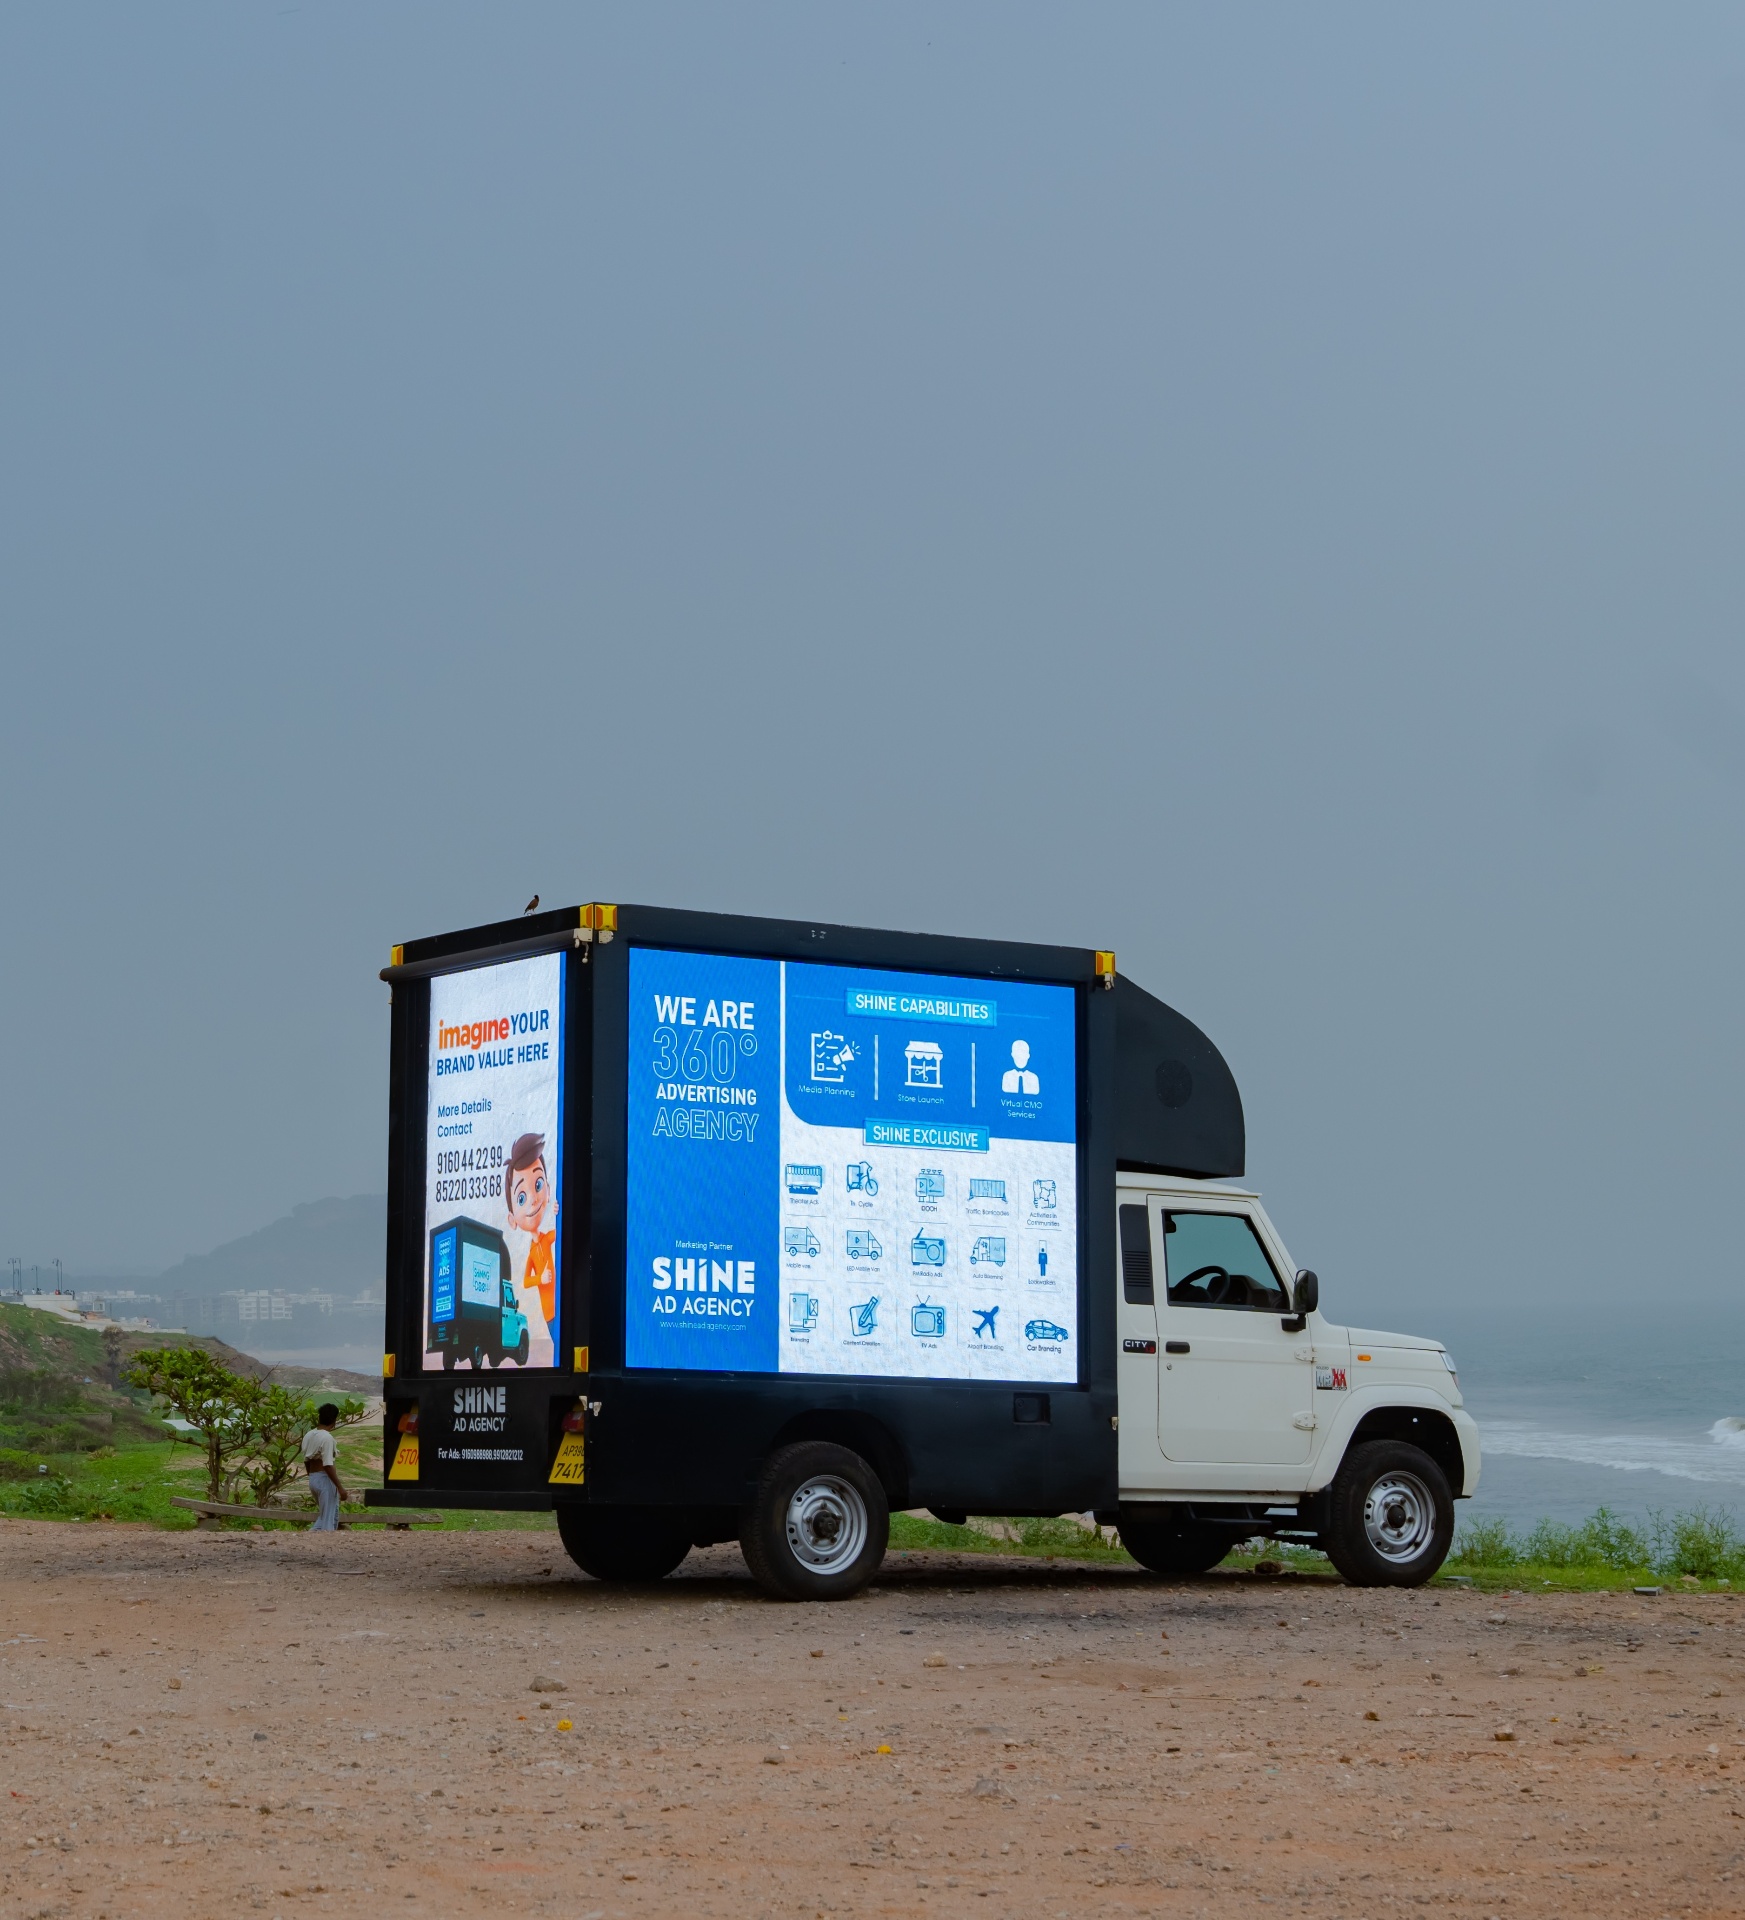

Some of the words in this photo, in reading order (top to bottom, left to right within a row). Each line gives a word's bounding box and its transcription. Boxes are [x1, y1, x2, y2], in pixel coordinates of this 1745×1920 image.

[654, 994, 696, 1026] WE
[702, 999, 755, 1030] ARE
[855, 994, 897, 1011] SHINE
[900, 998, 989, 1019] CAPABILITIES
[439, 1018, 510, 1050] imagine
[511, 1009, 549, 1035] YOUR
[436, 1054, 475, 1076] BRAND
[478, 1047, 514, 1069] VALUE
[517, 1042, 549, 1064] HERE
[656, 1083, 757, 1106] ADVERTISING
[798, 1085, 823, 1094] Media
[824, 1086, 855, 1098] Planning
[898, 1094, 916, 1102] Store
[918, 1094, 944, 1104] Launch
[437, 1105, 459, 1118] More
[461, 1098, 492, 1115] Details
[1001, 1099, 1022, 1108] Virtual
[1024, 1100, 1042, 1109] CMO
[1008, 1110, 1036, 1119] Services
[437, 1121, 473, 1138] Contact
[652, 1106, 760, 1143] AGENCY
[873, 1125, 910, 1143] SHINE
[913, 1129, 978, 1147] EXCLUSIVE
[676, 1240, 707, 1251] Marketing
[709, 1241, 733, 1251] Partner
[652, 1295, 677, 1314] AD
[682, 1297, 754, 1317] AGENCY
[1026, 1344, 1038, 1352] Car
[1038, 1345, 1062, 1354] Branding
[1125, 1340, 1148, 1348] CITY
[453, 1417, 466, 1432] AD
[469, 1417, 506, 1432] AGENCY
[438, 1447, 448, 1459] For
